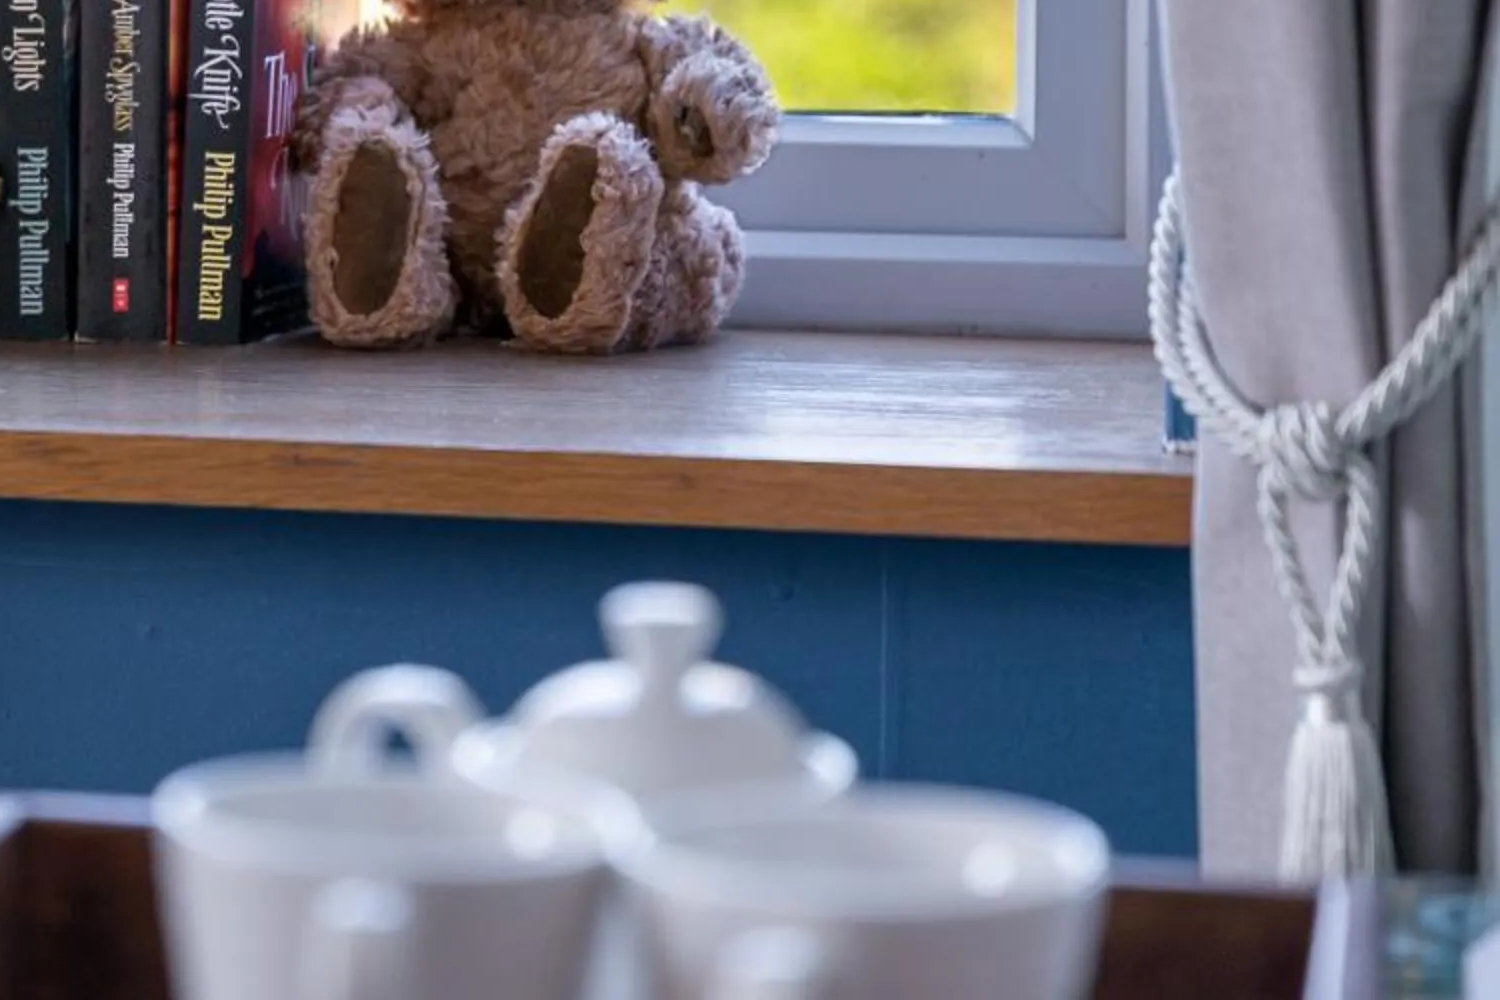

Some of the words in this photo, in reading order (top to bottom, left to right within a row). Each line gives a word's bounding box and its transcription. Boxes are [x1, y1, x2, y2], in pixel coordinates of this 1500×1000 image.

[2, 12, 47, 92] Lights
[188, 34, 243, 129] Knife
[105, 57, 141, 131] Spyglass
[8, 146, 49, 215] Philip
[106, 143, 136, 190] Philip
[192, 151, 236, 219] Philip
[112, 192, 136, 259] Pullman
[19, 220, 50, 316] Pullman
[198, 225, 234, 321] Pullman
